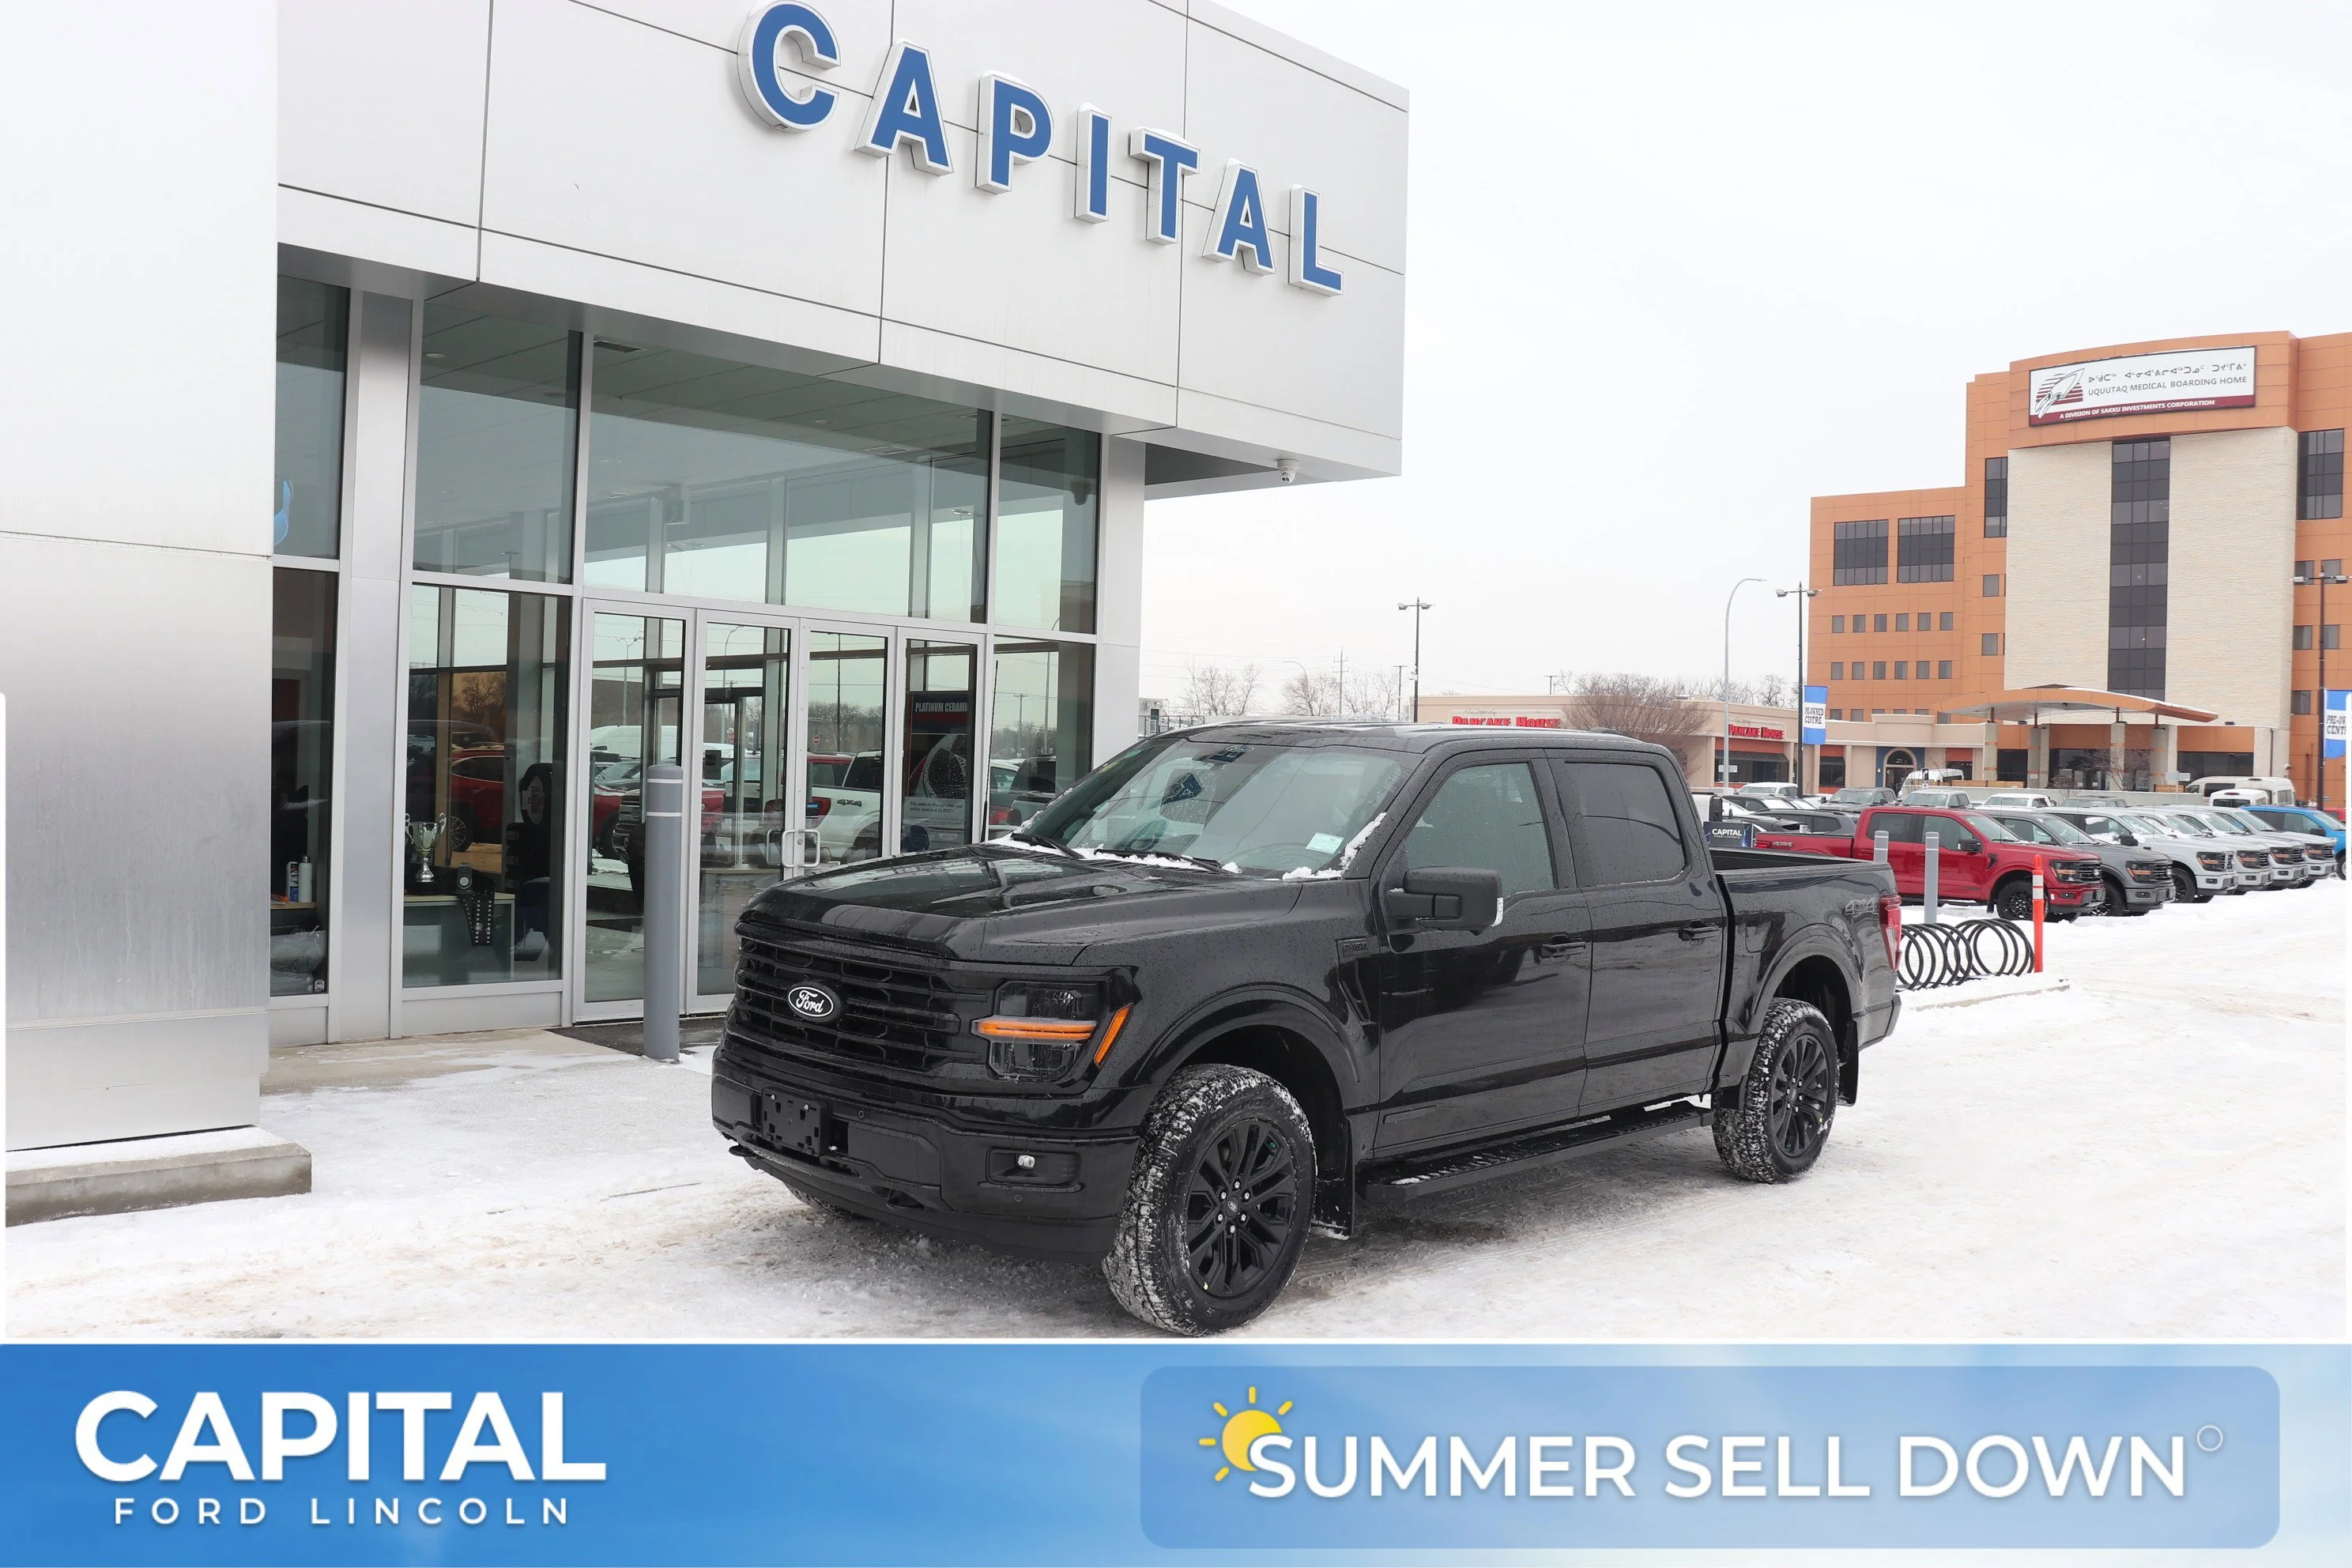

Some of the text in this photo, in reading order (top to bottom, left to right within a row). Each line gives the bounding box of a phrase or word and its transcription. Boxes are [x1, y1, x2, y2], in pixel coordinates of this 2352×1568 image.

[738, 0, 1344, 297] CAPITAL
[2088, 385, 2128, 396] UQUUTAQ
[2130, 383, 2167, 391] MEDICAL
[2170, 378, 2218, 388] BOARDING
[2122, 403, 2165, 412] INVESTMENTS
[2166, 399, 2215, 409] CORPORATION
[915, 702, 944, 712] PLATINUM
[1728, 723, 1785, 740] PANCAKE HOUSE
[796, 989, 824, 1013] Ford
